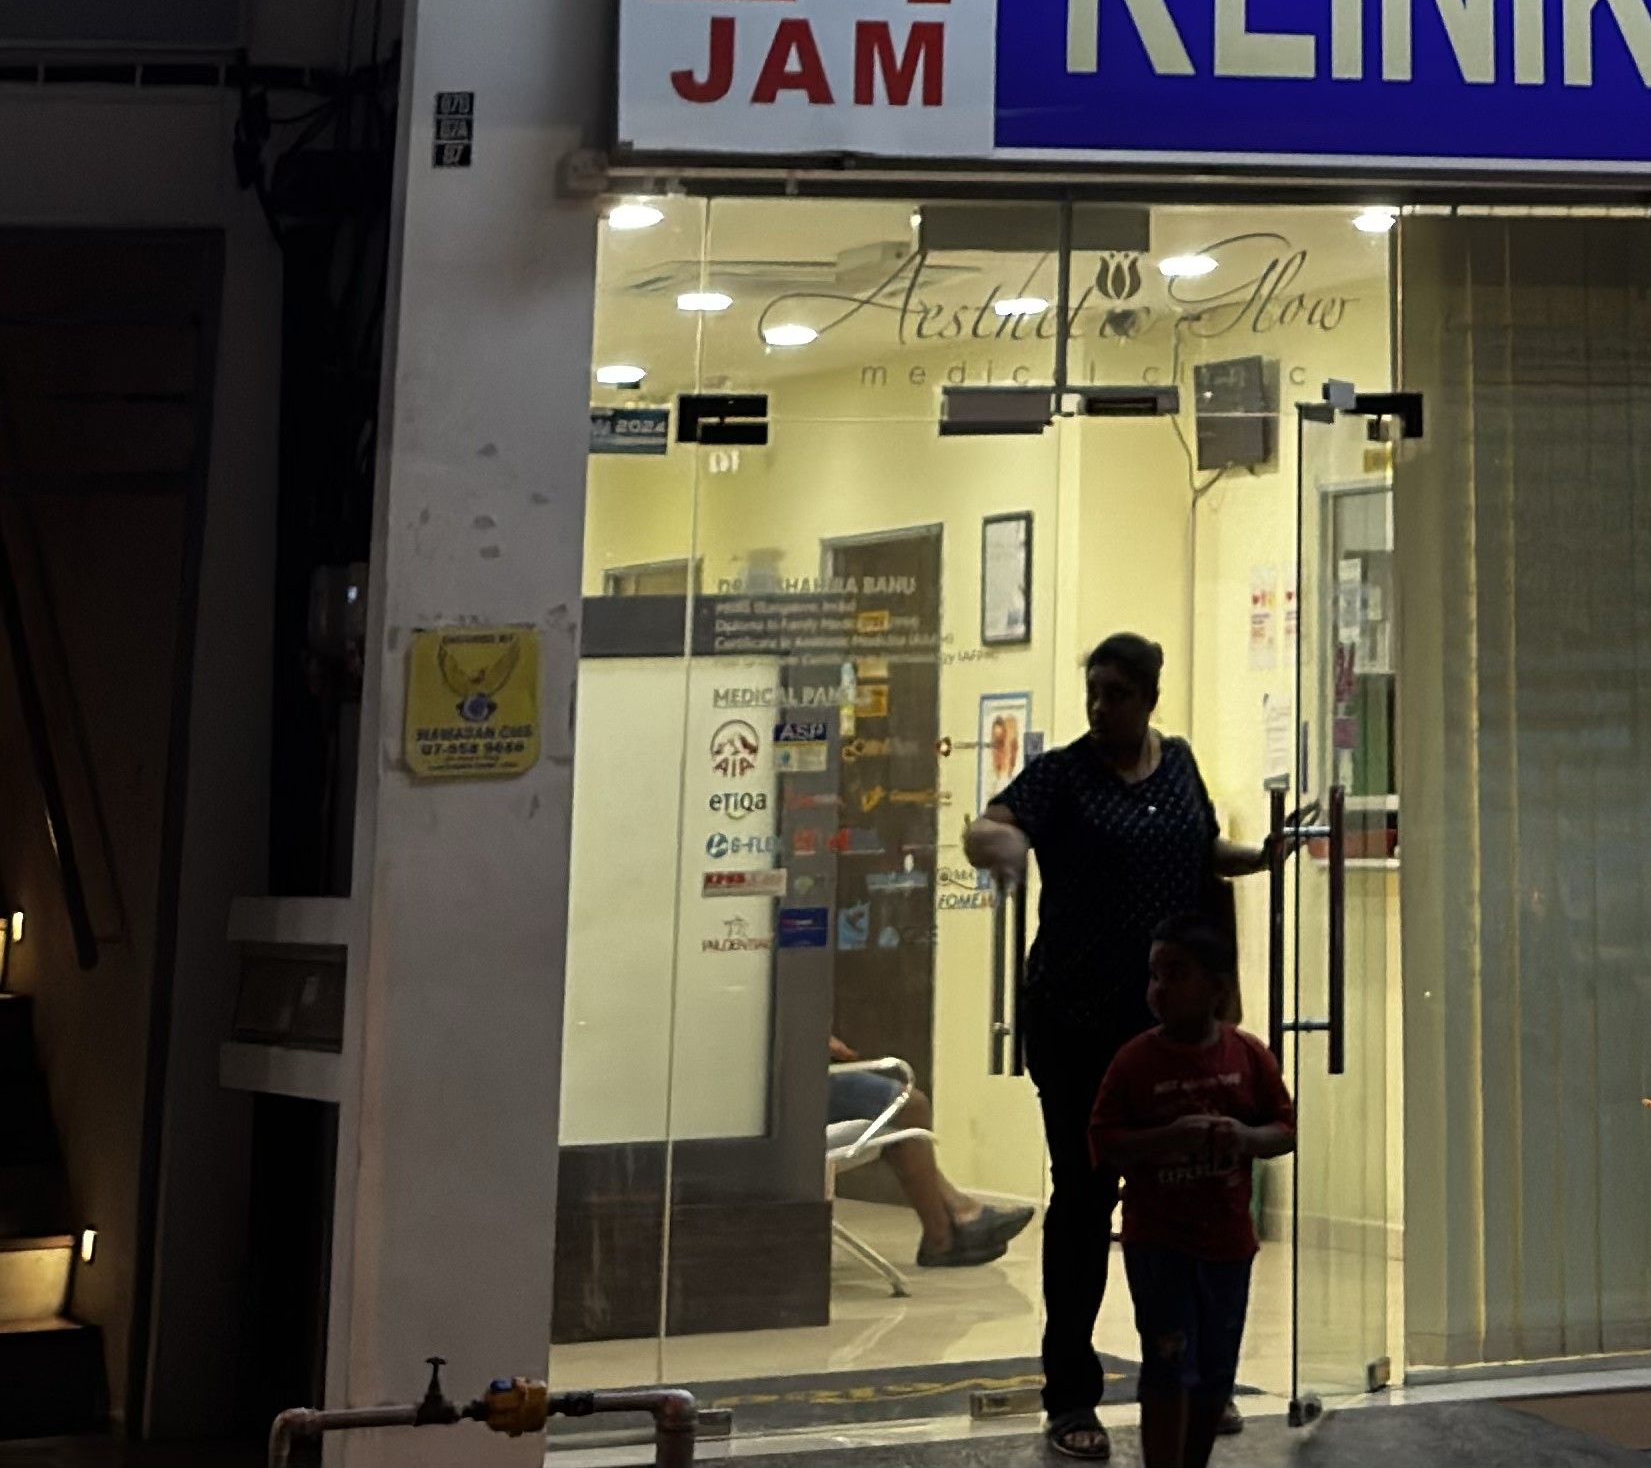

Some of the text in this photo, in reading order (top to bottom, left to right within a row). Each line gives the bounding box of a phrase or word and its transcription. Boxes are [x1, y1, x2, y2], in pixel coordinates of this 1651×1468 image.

[669, 16, 945, 108] JAM
[861, 359, 1097, 387] medicl
[614, 418, 667, 434] 2024
